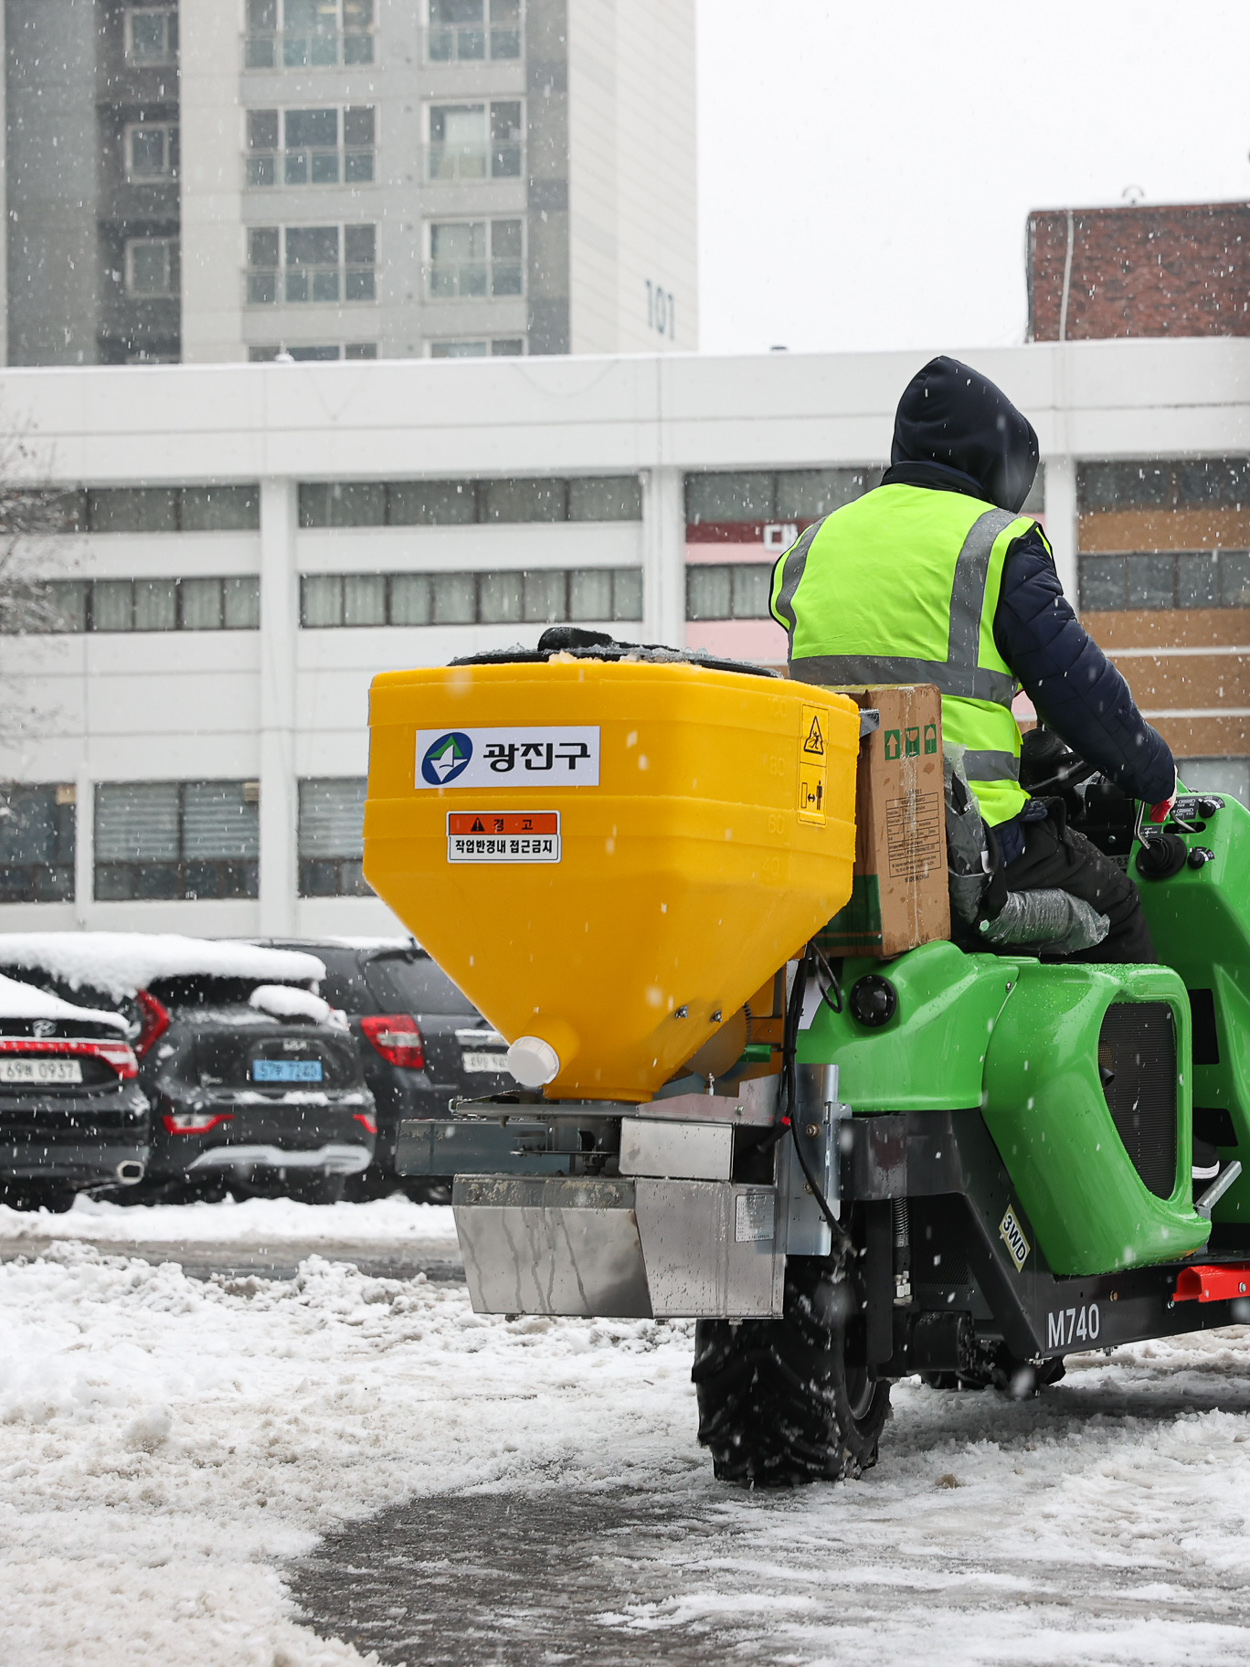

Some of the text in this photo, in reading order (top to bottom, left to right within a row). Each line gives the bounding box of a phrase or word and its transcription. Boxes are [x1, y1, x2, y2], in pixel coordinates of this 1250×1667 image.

[644, 279, 675, 340] 101
[482, 742, 591, 773] 광진구
[493, 818, 533, 832] 경 고
[767, 814, 785, 834] 60
[455, 839, 553, 854] 작업반경내 접근금지
[39, 1062, 73, 1079] 0937
[1003, 1215, 1026, 1261] 3WD
[1048, 1303, 1100, 1348] M740
